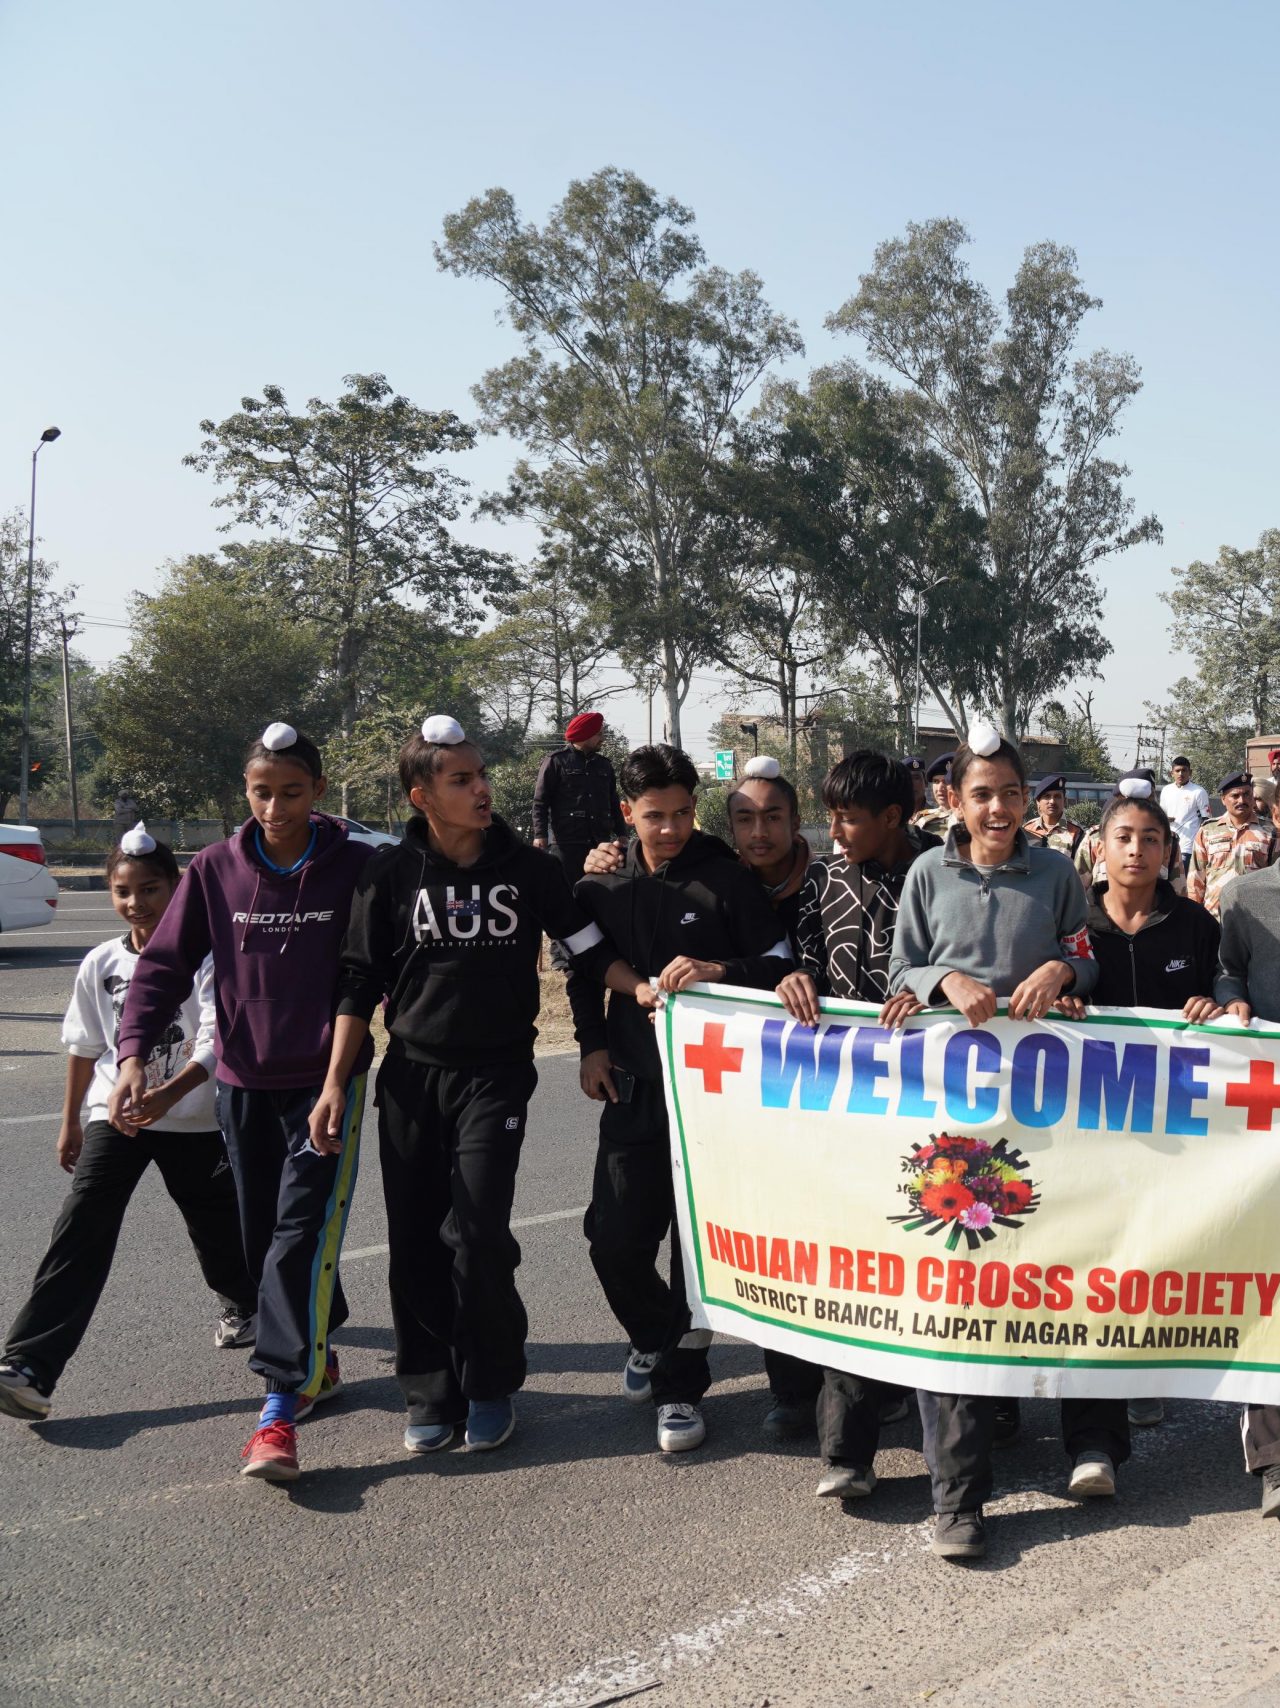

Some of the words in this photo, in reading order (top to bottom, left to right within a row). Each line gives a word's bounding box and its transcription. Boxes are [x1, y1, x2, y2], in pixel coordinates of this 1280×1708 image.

[413, 884, 519, 942] AUS
[761, 1019, 1210, 1136] WELCOME
[706, 1221, 819, 1286] INDIAN
[829, 1245, 905, 1297] RED
[916, 1256, 1074, 1311] CROSS
[734, 1278, 808, 1316] DISTRICT
[814, 1298, 904, 1336] BRANCH,
[912, 1312, 996, 1342] LAJPAT
[1004, 1320, 1088, 1346] NAGAR
[1096, 1324, 1240, 1349] JALANDHAR
